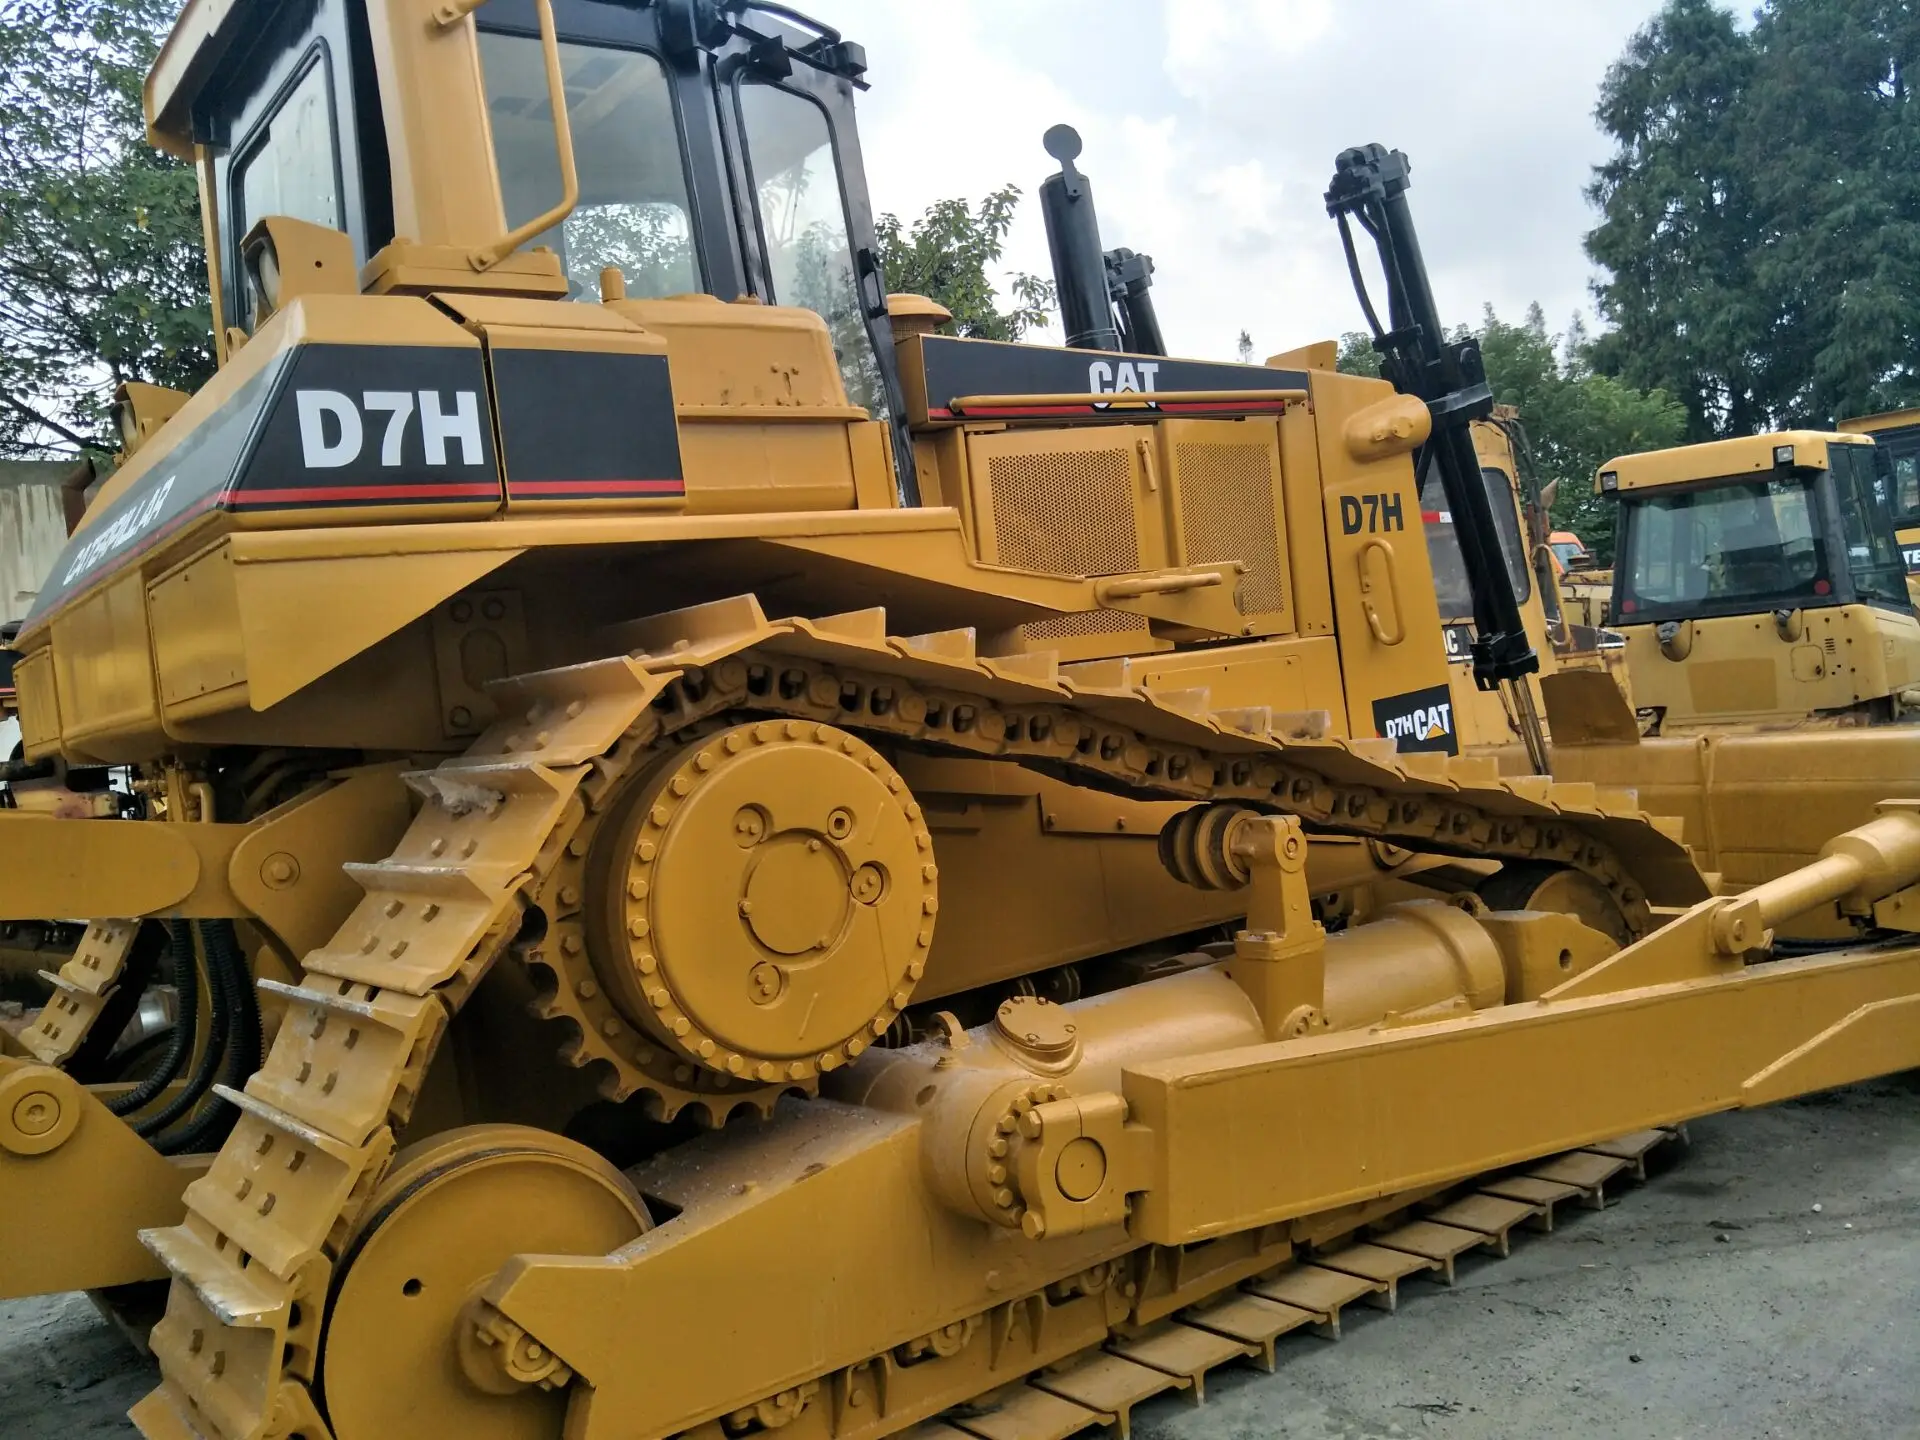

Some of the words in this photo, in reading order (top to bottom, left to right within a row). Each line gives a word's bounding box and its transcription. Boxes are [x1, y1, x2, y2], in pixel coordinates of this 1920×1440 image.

[1089, 361, 1159, 408] CAT
[296, 390, 484, 468] D7H
[1340, 493, 1404, 535] D7H
